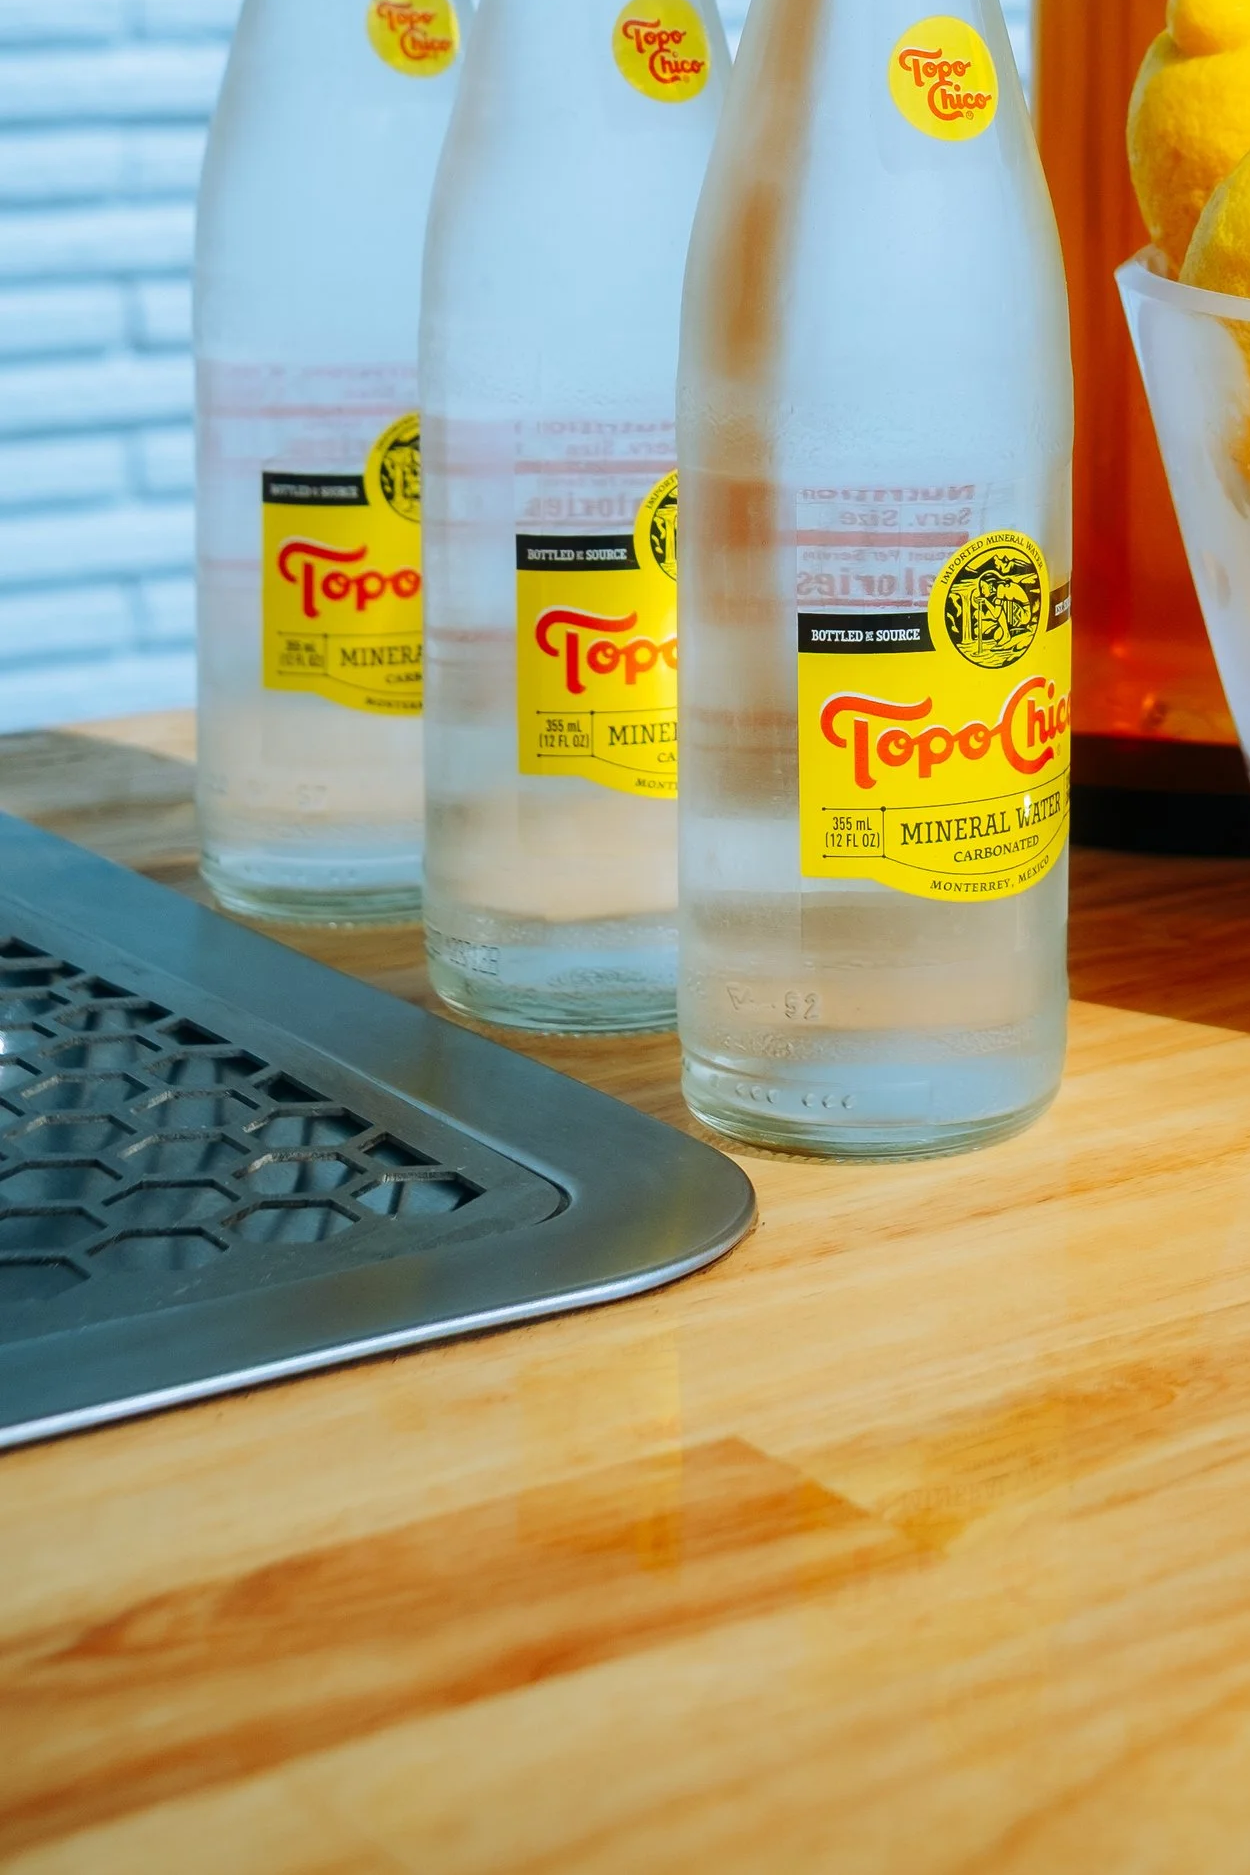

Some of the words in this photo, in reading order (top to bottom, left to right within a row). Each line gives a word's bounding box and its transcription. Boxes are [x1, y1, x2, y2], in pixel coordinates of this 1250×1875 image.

[376, 0, 437, 32] Topo
[400, 28, 453, 60] Chico
[621, 18, 686, 54] Topo
[648, 48, 705, 84] Chico
[898, 47, 971, 87] Topo
[927, 80, 992, 121] Chico
[527, 548, 575, 561] BOTTLED
[585, 548, 628, 561] SOURCE
[940, 540, 984, 585] IMPORTED
[986, 533, 1024, 547] MINERAL
[277, 536, 421, 619] Topo
[811, 629, 864, 642] BOTTLED
[876, 628, 920, 642] SOURCE
[546, 719, 564, 733] 355
[820, 691, 999, 790] Topo
[832, 816, 853, 831] 355
[856, 816, 873, 831] mL
[900, 810, 1011, 846] MINERAL
[1016, 790, 1061, 829] WATER
[825, 832, 843, 848] (12
[846, 833, 860, 848] FL
[862, 832, 880, 848] OZ)
[953, 834, 1040, 863] CARBONATED
[930, 878, 1015, 893] MONTERREY,
